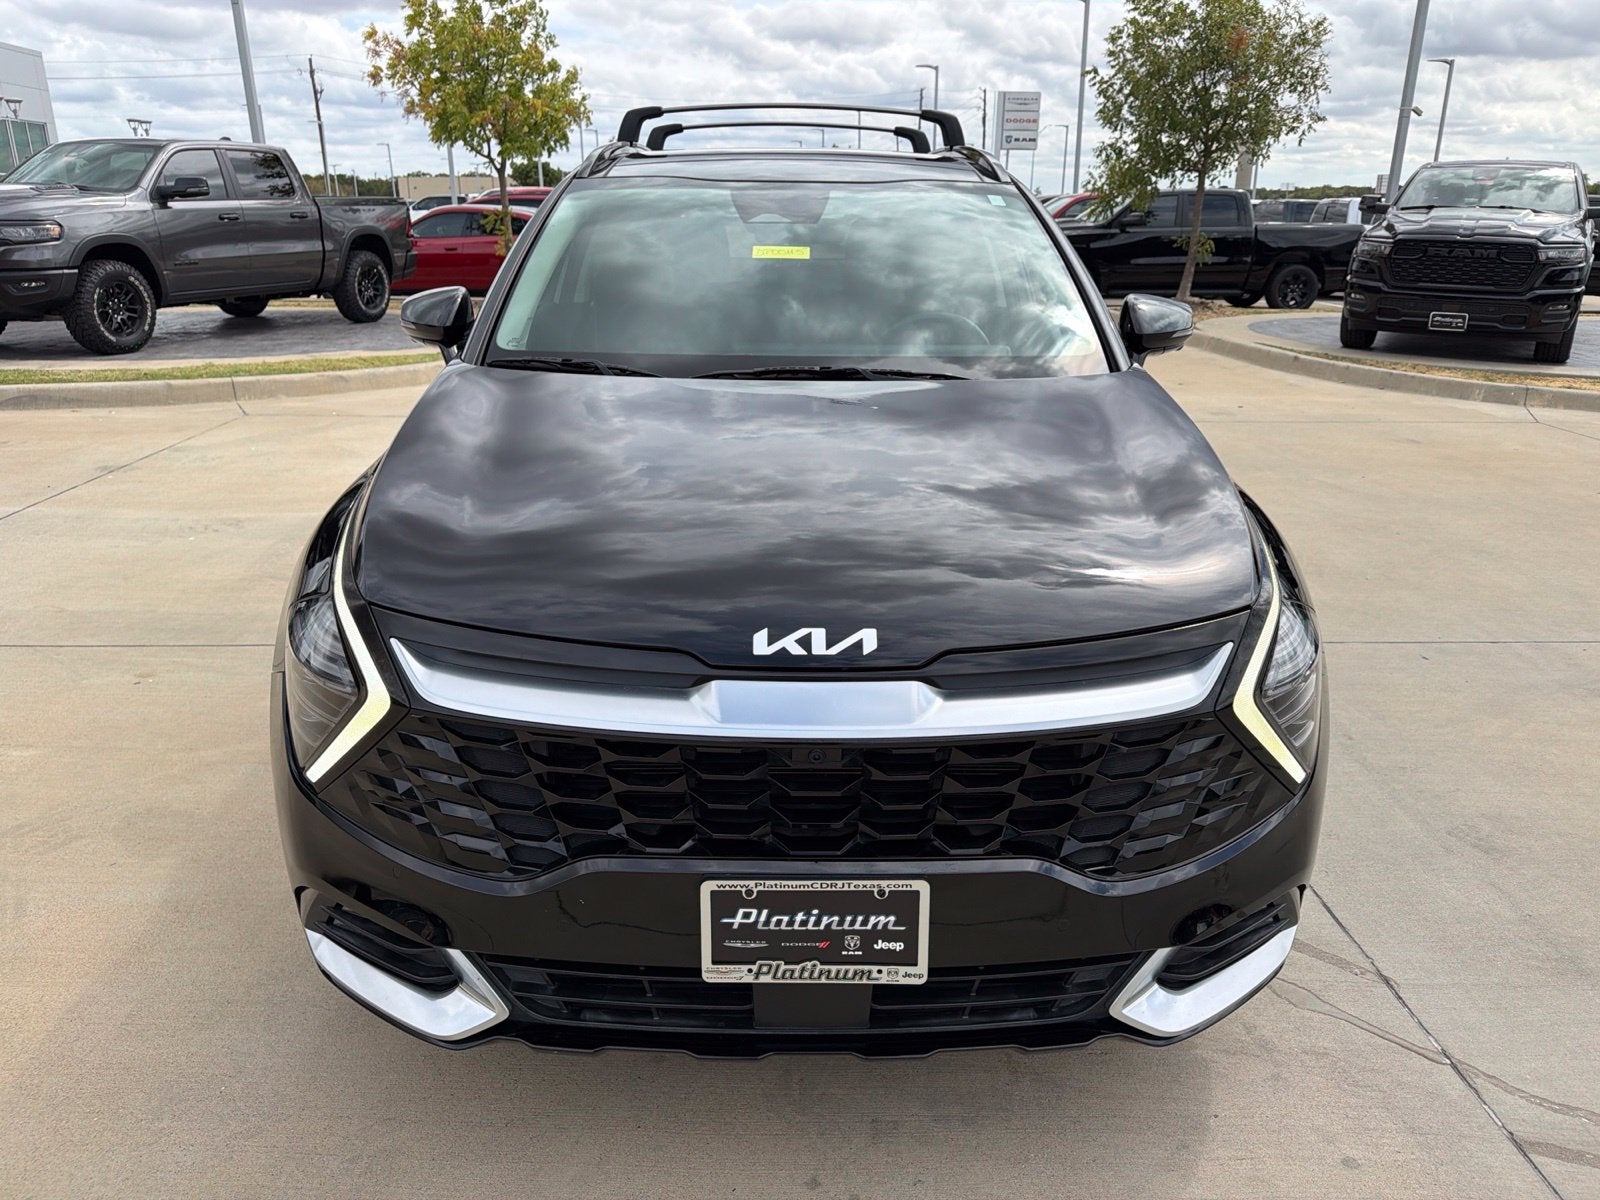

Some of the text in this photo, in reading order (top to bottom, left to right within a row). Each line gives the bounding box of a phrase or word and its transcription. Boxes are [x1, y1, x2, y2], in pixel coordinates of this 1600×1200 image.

[1426, 247, 1498, 258] RAM
[753, 627, 877, 655] KIA
[716, 882, 913, 890] www.PlatinumCDRJTexas.com
[720, 908, 907, 930] Platinum
[873, 939, 905, 952] Jeep
[747, 961, 883, 982] Platinum
[902, 971, 924, 979] Jeep
